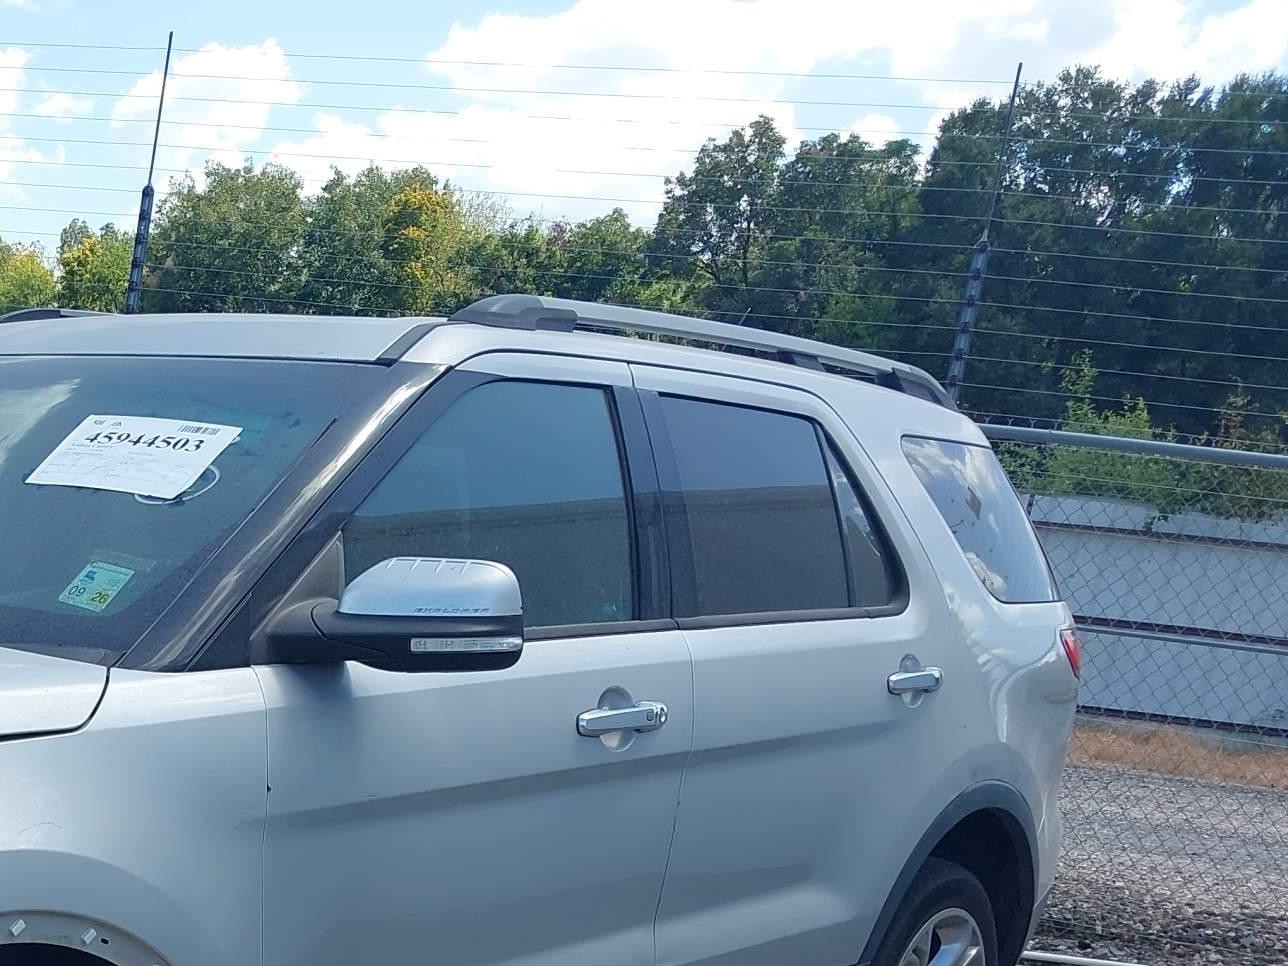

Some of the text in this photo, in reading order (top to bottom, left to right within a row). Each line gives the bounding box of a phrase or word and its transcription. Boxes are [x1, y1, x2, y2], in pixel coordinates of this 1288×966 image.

[85, 431, 206, 452] 45944503
[68, 585, 87, 597] 09
[90, 591, 110, 604] 26
